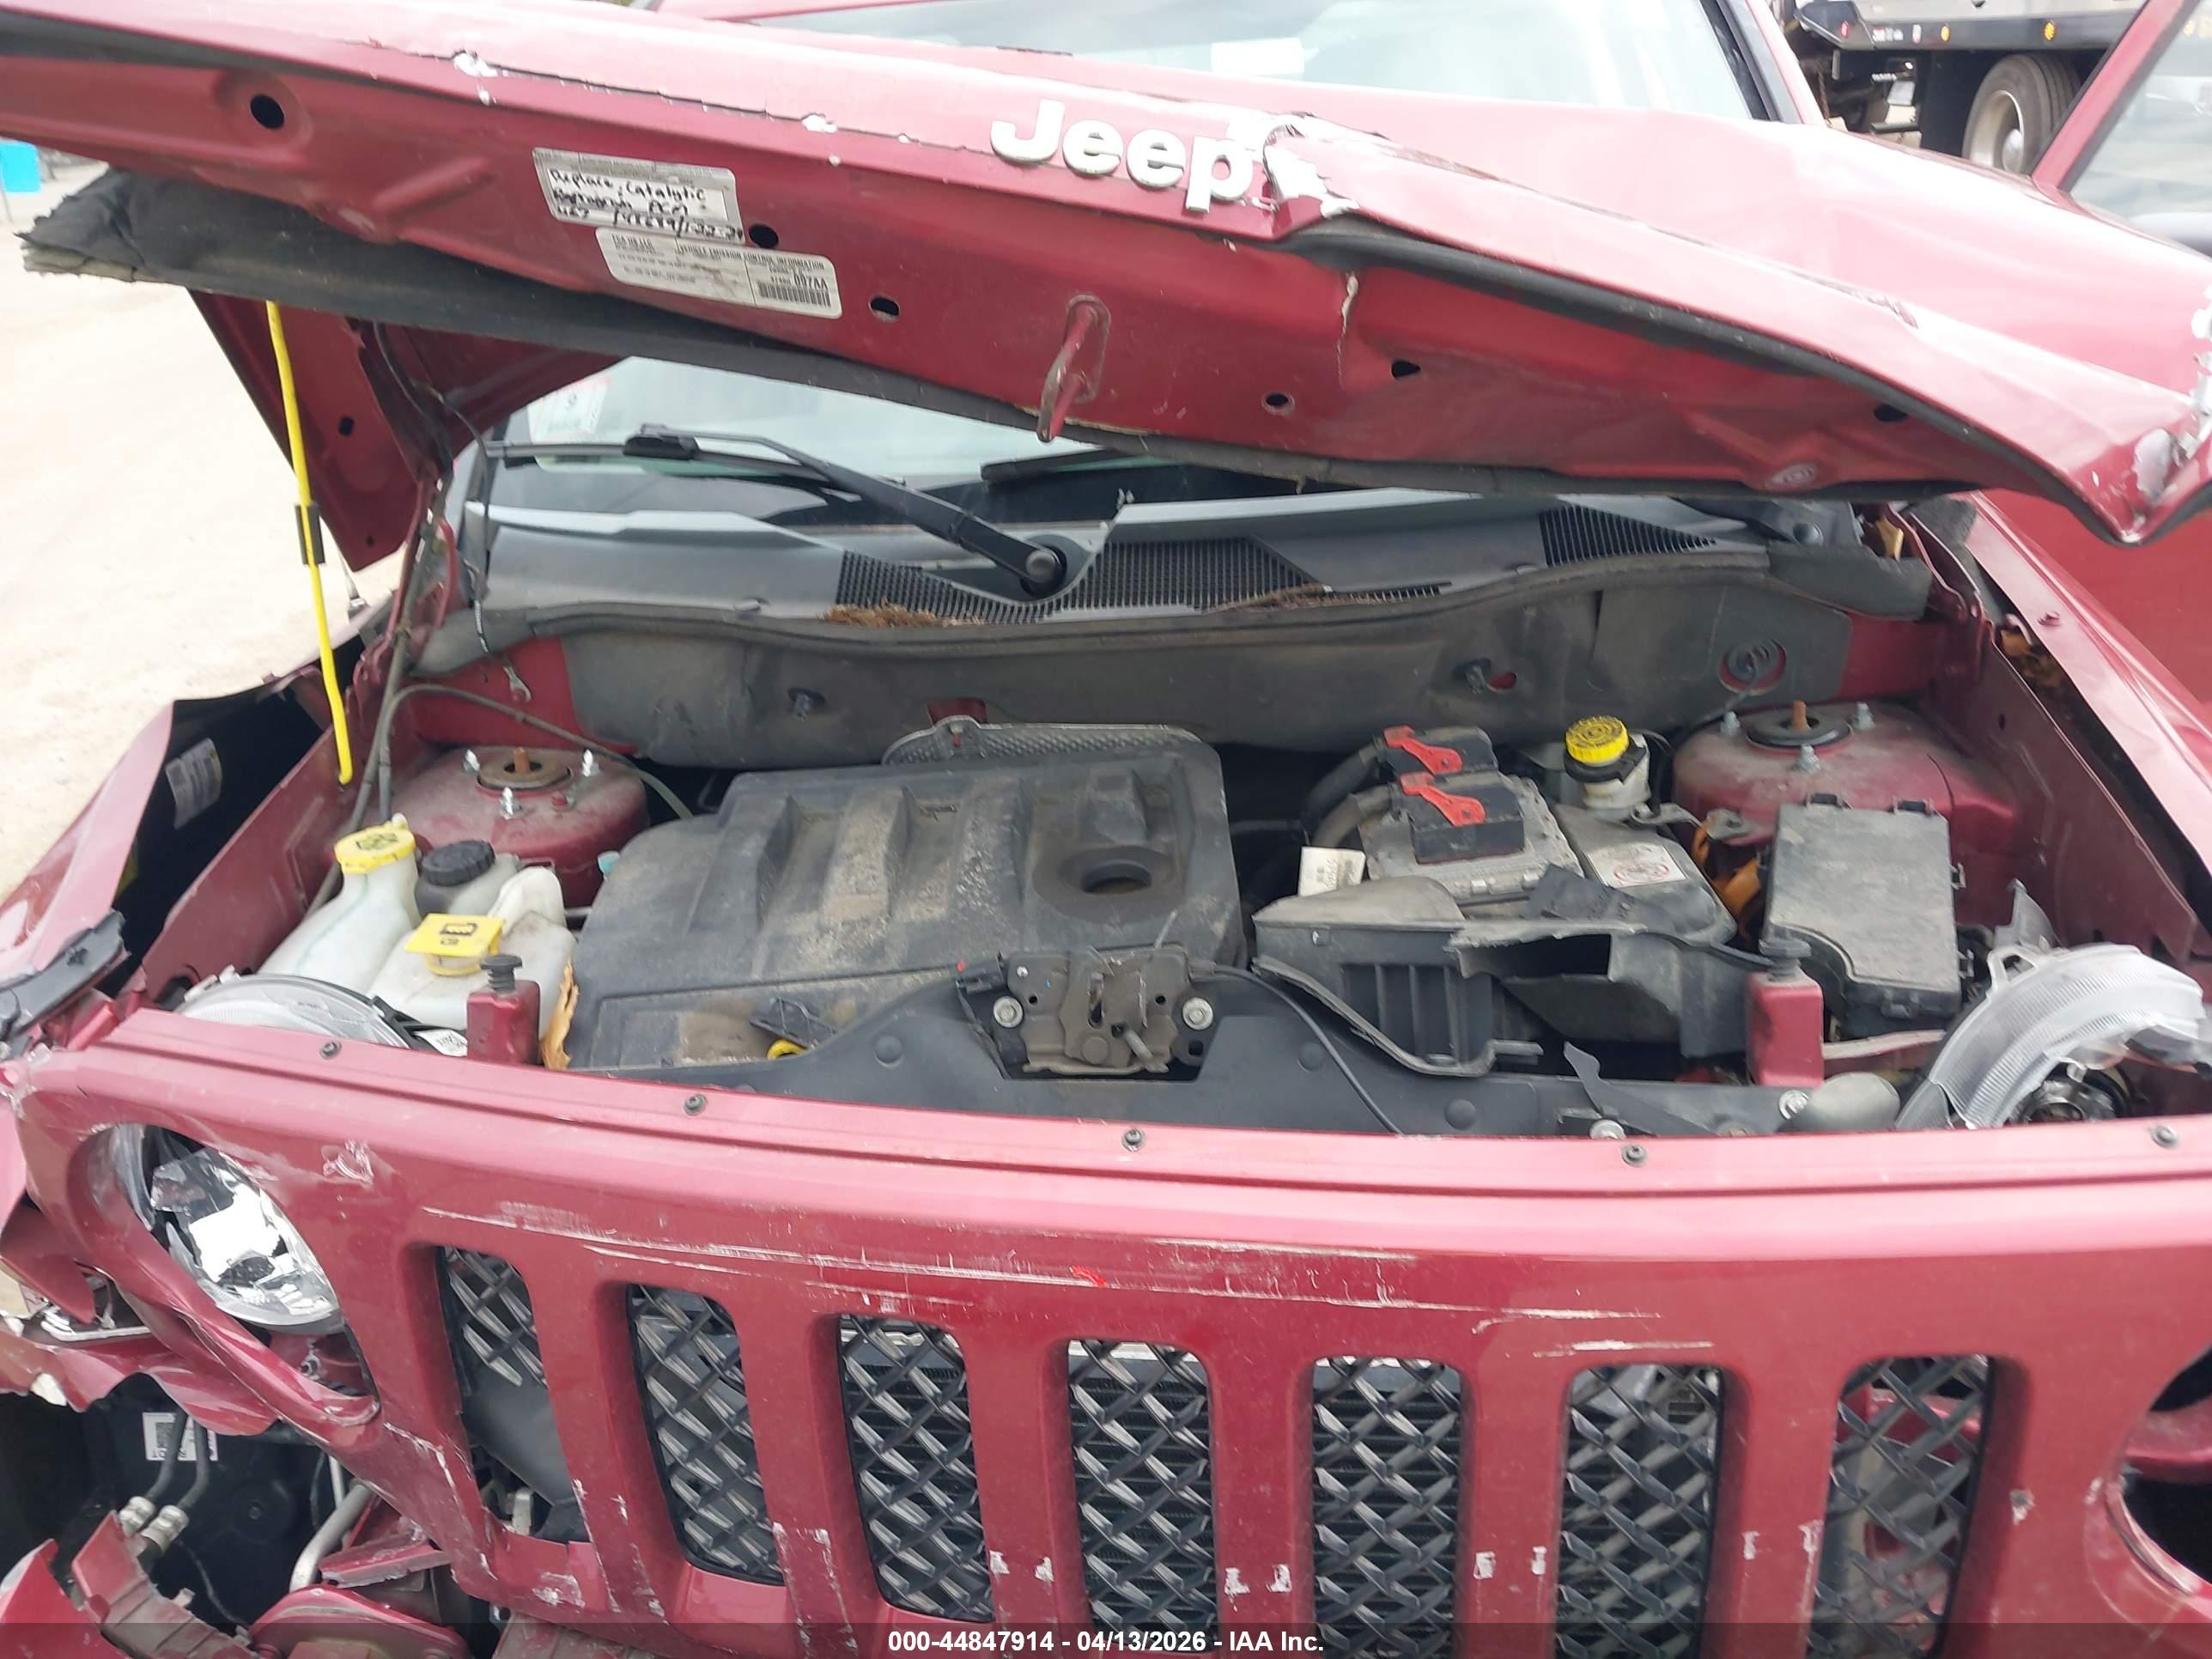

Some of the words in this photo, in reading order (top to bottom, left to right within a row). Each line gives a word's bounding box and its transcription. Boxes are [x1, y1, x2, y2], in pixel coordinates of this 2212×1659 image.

[990, 99, 1255, 213] Jeep
[708, 247, 742, 259] EMISSION
[744, 252, 774, 264] CONTROL
[776, 256, 825, 270] INFORMATION
